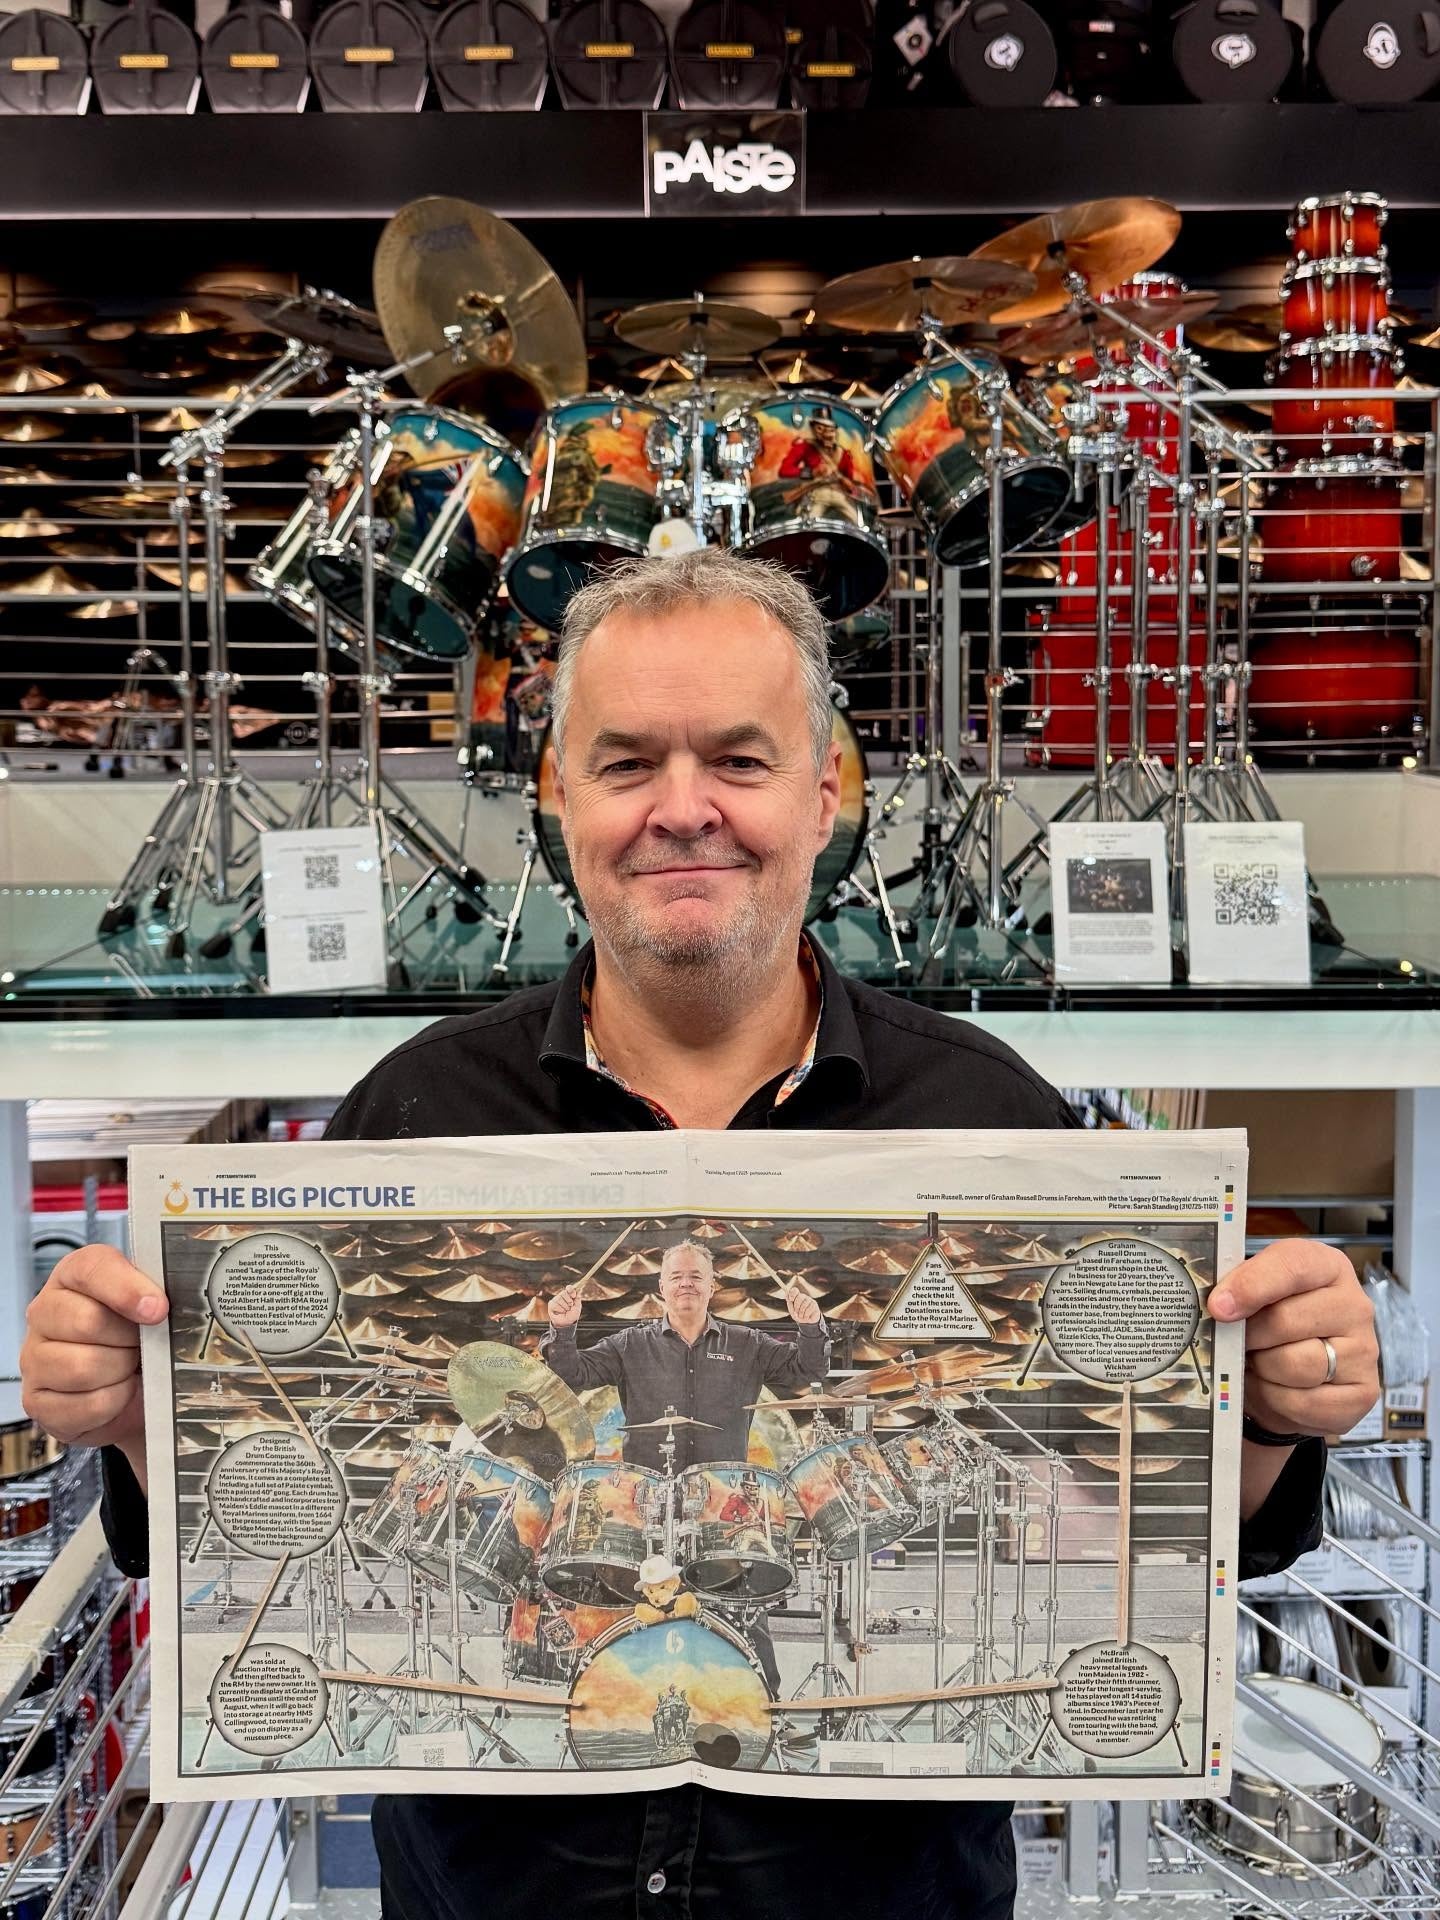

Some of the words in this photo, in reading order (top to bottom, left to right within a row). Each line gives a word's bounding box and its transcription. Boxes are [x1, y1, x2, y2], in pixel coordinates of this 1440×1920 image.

[192, 1187, 245, 1208] THE
[251, 1187, 297, 1208] BIG
[302, 1186, 416, 1207] PICTURE
[1064, 1194, 1092, 1202] Fareham,
[253, 1251, 290, 1260] impressive
[299, 1258, 305, 1266] is
[1111, 1257, 1143, 1265] Fareham,
[1075, 1264, 1098, 1273] largest
[1118, 1265, 1135, 1274] shop
[276, 1274, 305, 1282] specially
[294, 1288, 303, 1297] gig
[304, 1288, 312, 1296] at
[312, 1288, 324, 1296] the
[217, 1296, 237, 1305] Royal
[309, 1296, 329, 1305] Royal
[247, 1304, 267, 1312] Band,
[275, 1304, 290, 1312] part
[304, 1311, 326, 1319] Music,
[929, 1315, 949, 1323] Royal
[269, 1318, 287, 1327] place
[295, 1318, 317, 1326] March
[892, 1322, 918, 1330] Charity
[273, 1327, 290, 1335] year.
[259, 1437, 290, 1445] Designed
[265, 1452, 296, 1460] Company
[1080, 1664, 1101, 1672] heavy
[1122, 1664, 1148, 1672] legends
[218, 1688, 249, 1696] currently
[259, 1688, 283, 1696] display
[1086, 1722, 1110, 1730] touring
